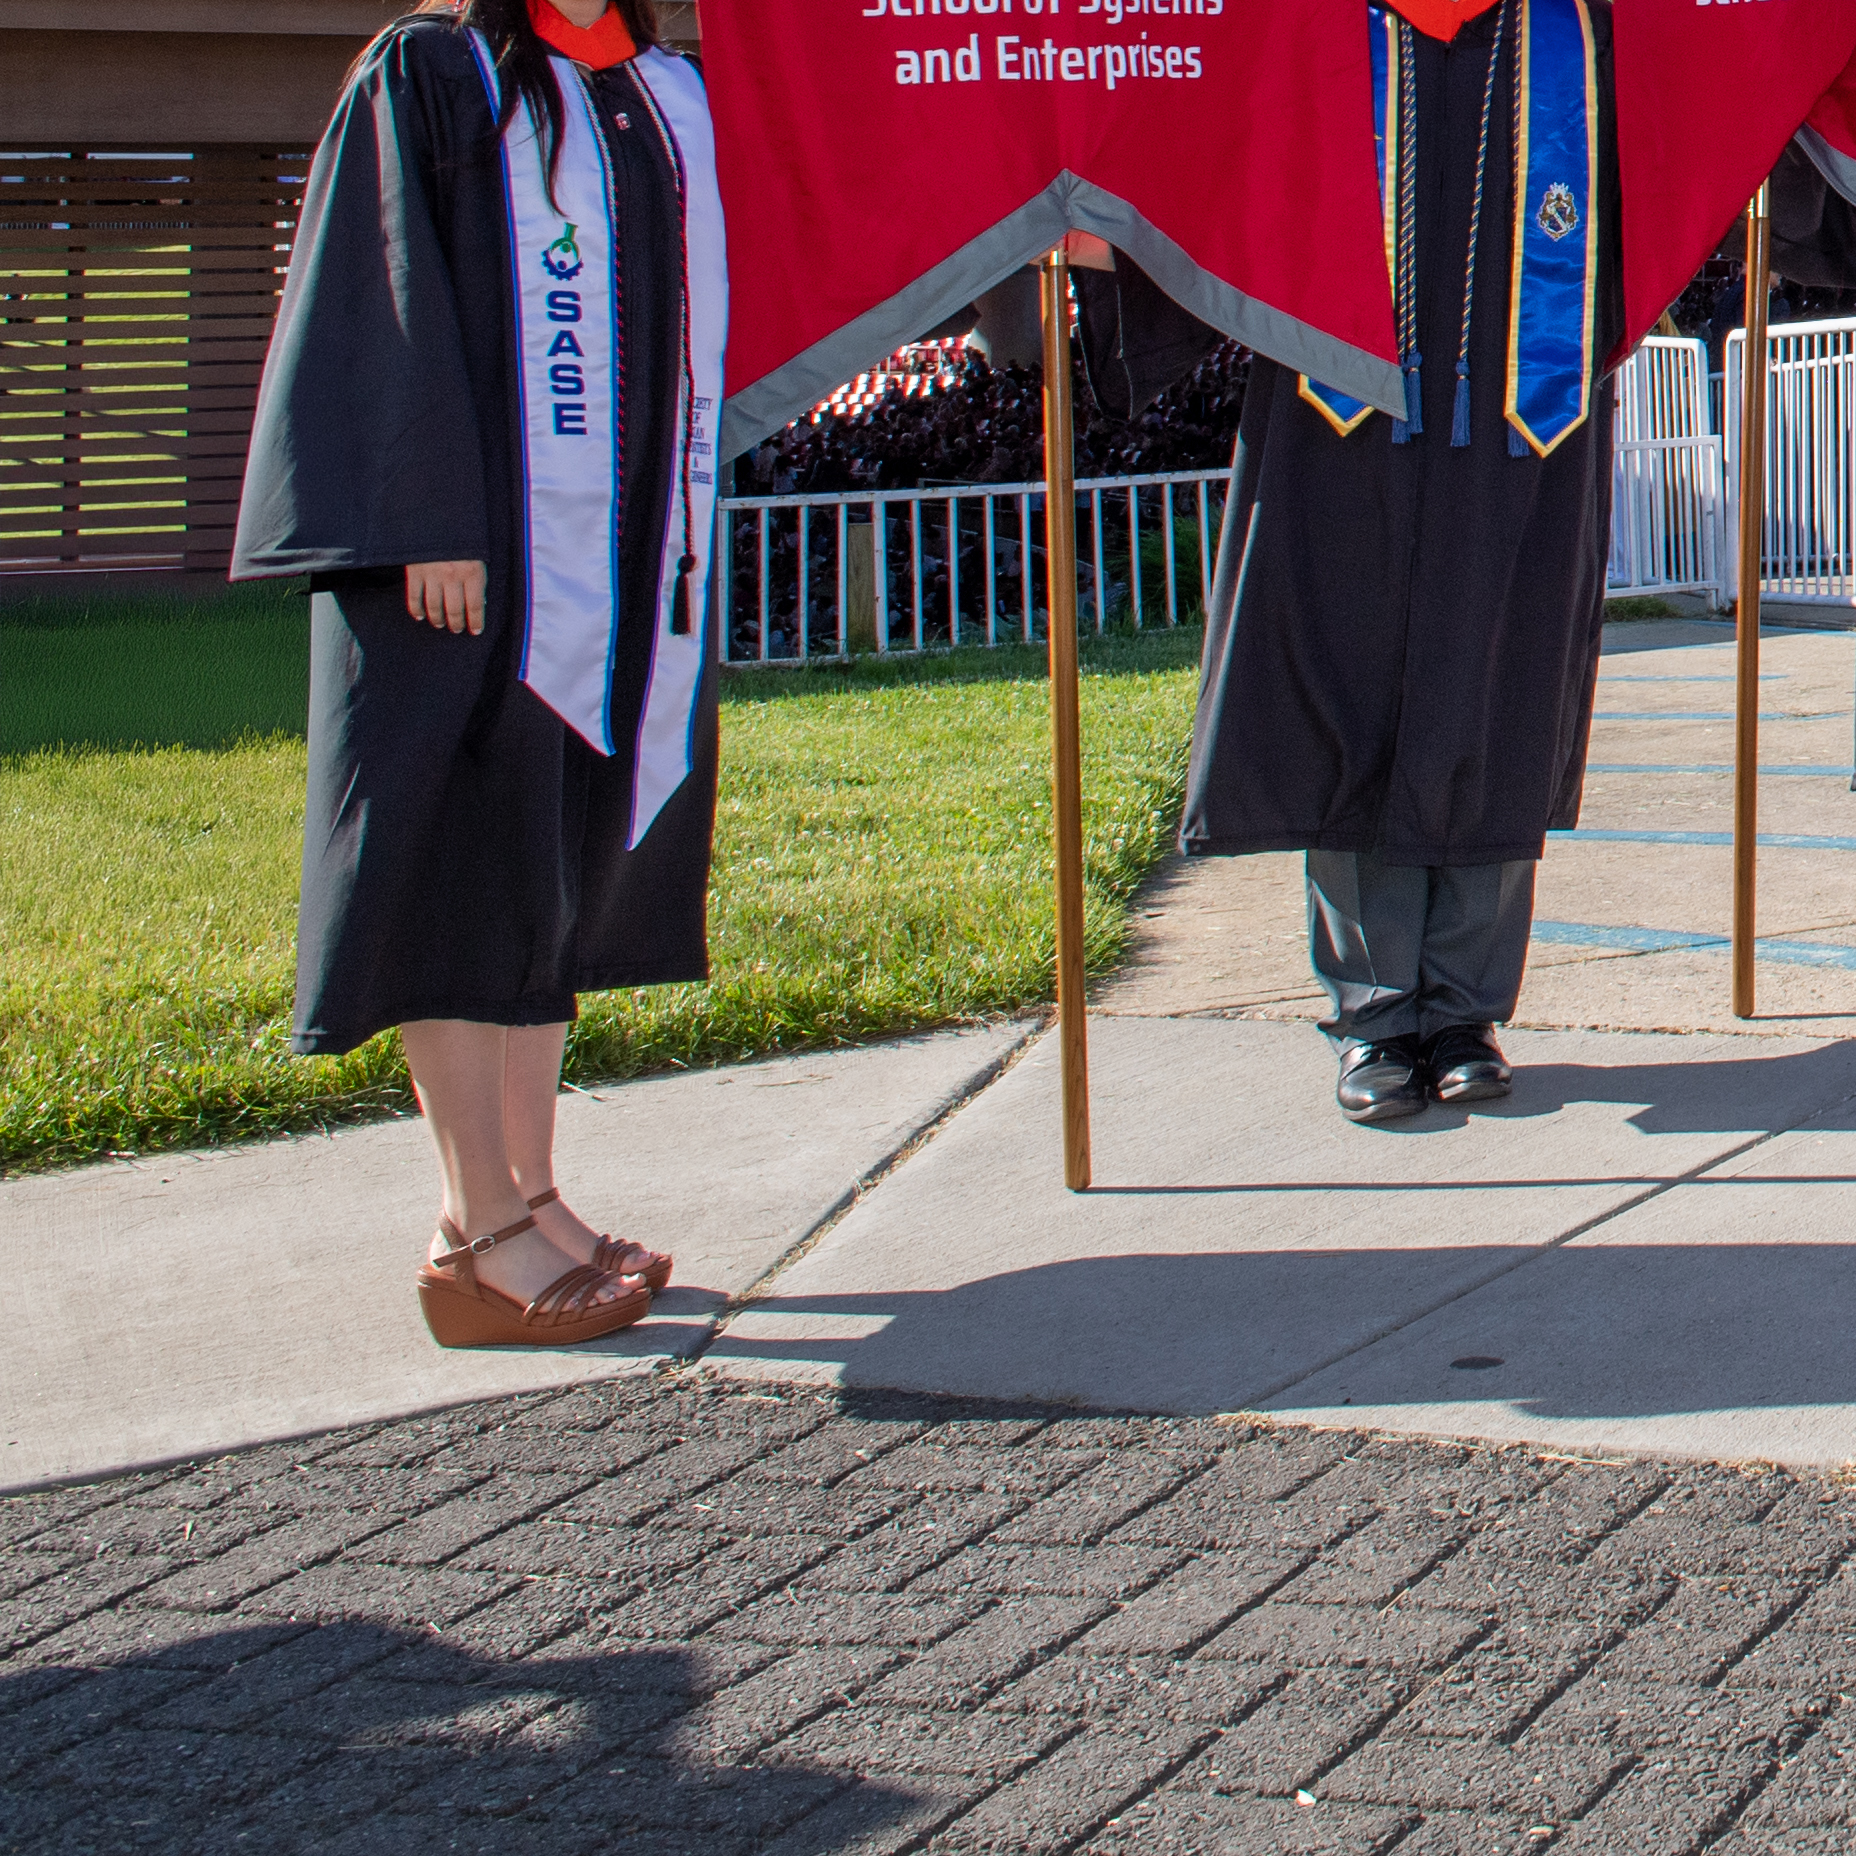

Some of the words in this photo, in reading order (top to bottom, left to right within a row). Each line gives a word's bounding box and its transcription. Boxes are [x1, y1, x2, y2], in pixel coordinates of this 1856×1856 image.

[895, 33, 981, 85] and
[996, 31, 1203, 91] Enterprises
[546, 290, 589, 435] SASE
